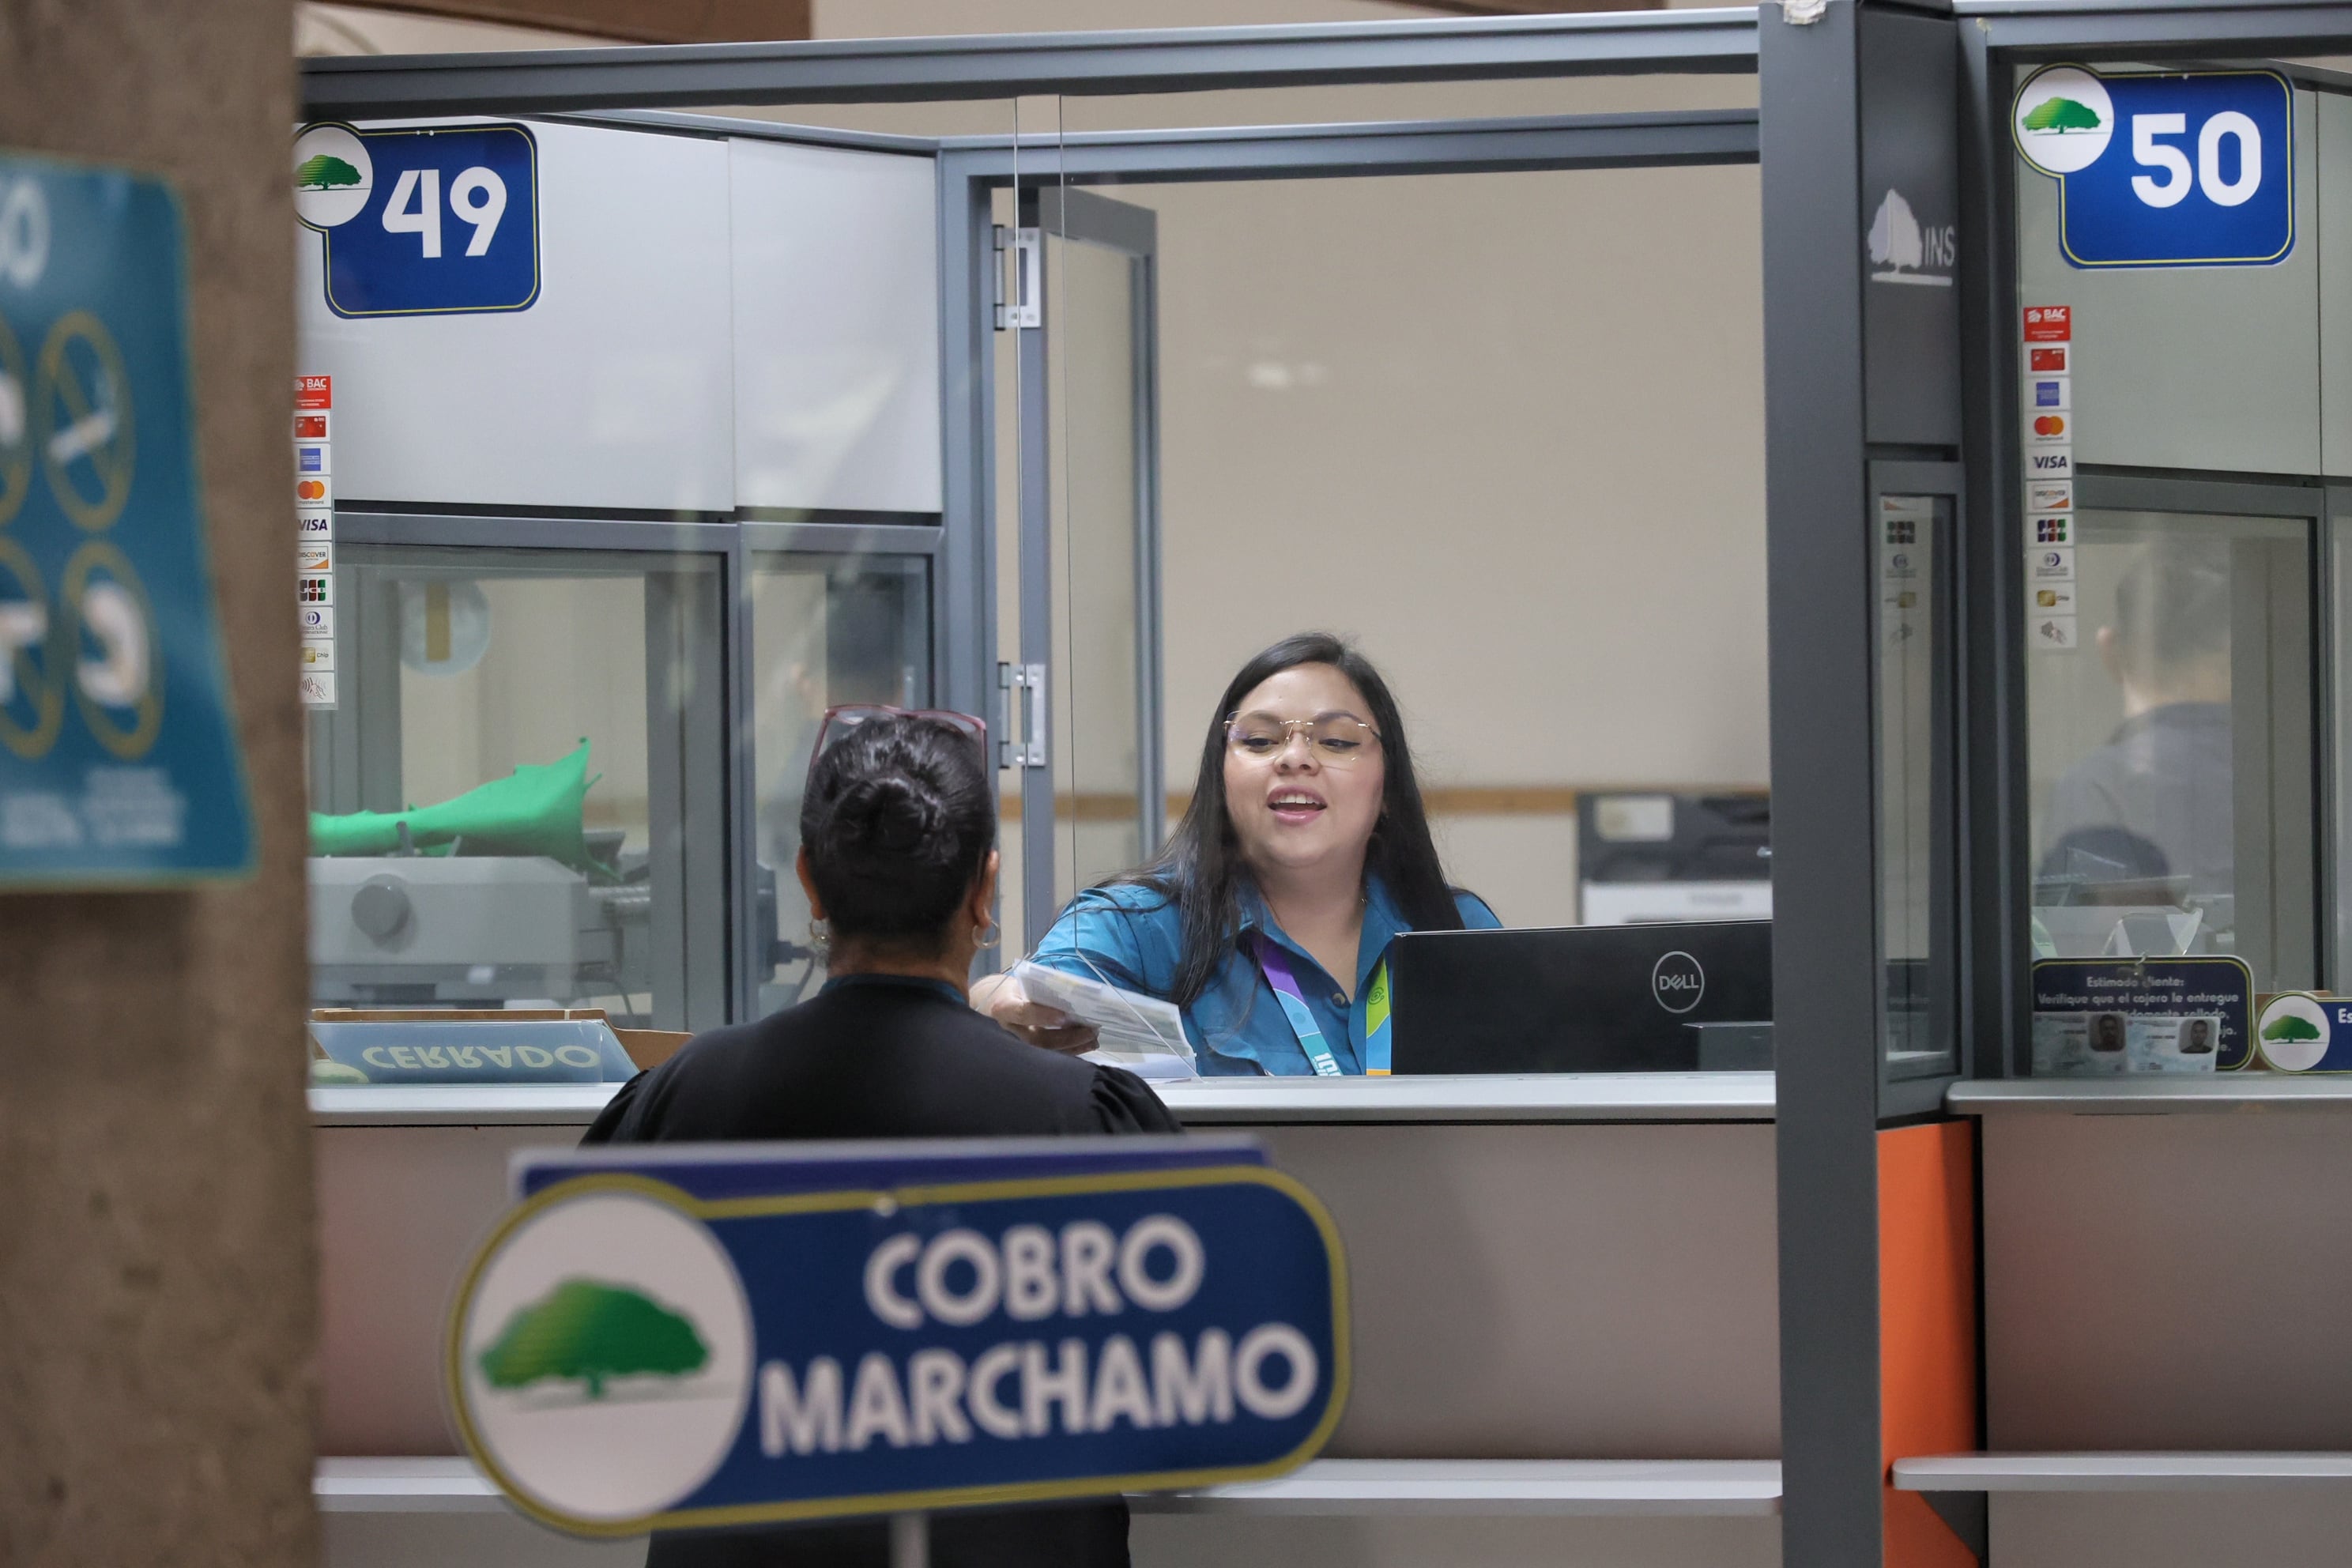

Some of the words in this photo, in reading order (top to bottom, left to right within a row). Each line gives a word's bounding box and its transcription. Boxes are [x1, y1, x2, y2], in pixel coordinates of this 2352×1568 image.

[2131, 111, 2262, 209] 50
[382, 166, 507, 258] 49
[1925, 225, 1955, 266] INS
[307, 379, 326, 388] BAC
[2034, 456, 2067, 469] VISA
[298, 519, 328, 531] VISA
[1659, 974, 1699, 990] DELL
[2086, 977, 2138, 987] Estimado
[2037, 993, 2088, 1006] Verifique
[2092, 997, 2115, 1006] que
[2119, 993, 2130, 1003] el
[2133, 993, 2168, 1005] cajero
[2172, 992, 2183, 1003] le
[2187, 993, 2239, 1005] entregue
[865, 1215, 1204, 1329] COBRO
[760, 1323, 1317, 1457] MARCHAMO
